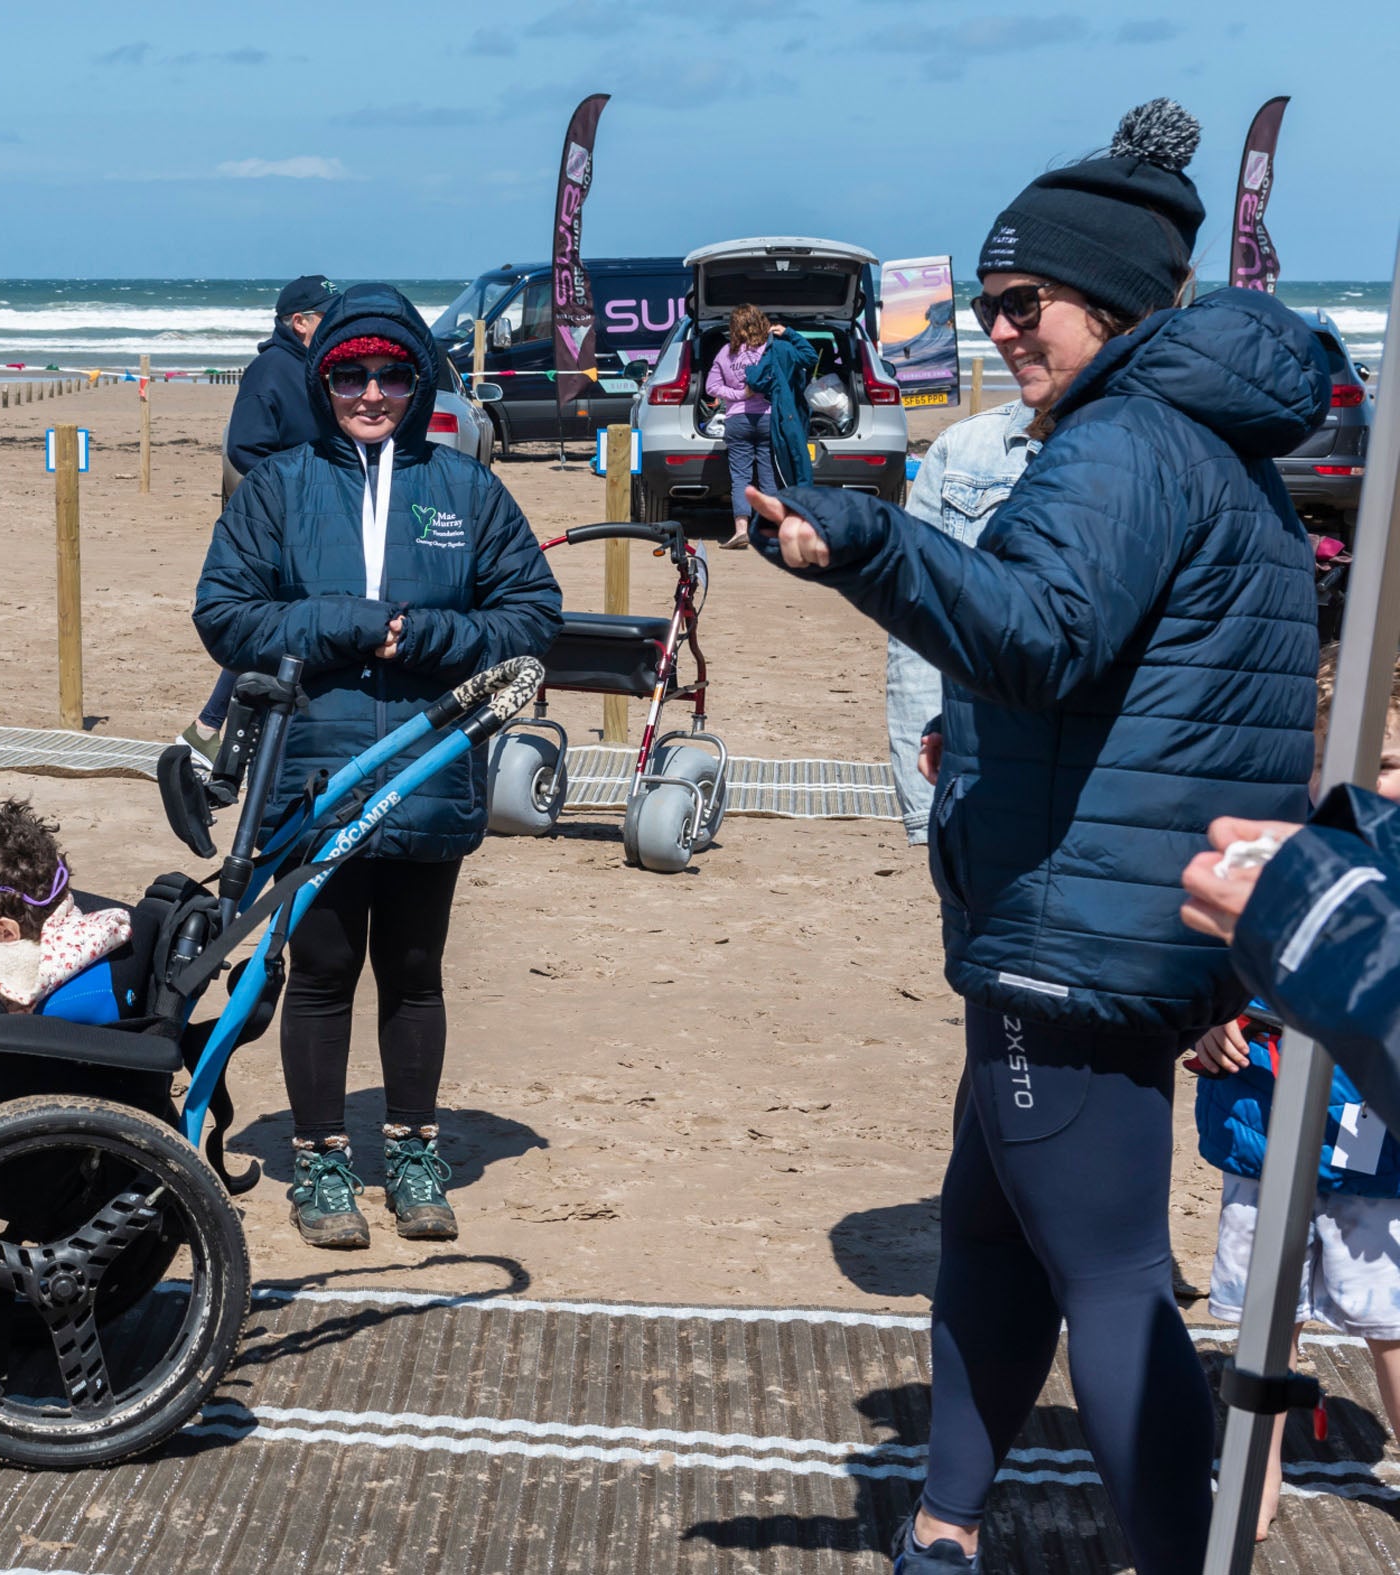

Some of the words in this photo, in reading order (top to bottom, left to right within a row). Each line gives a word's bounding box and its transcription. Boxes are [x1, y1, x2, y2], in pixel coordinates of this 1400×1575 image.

[573, 266, 588, 305] SURF
[605, 297, 686, 333] SU
[904, 395, 926, 406] SF65
[438, 512, 456, 520] Mac
[432, 519, 463, 528] Murray
